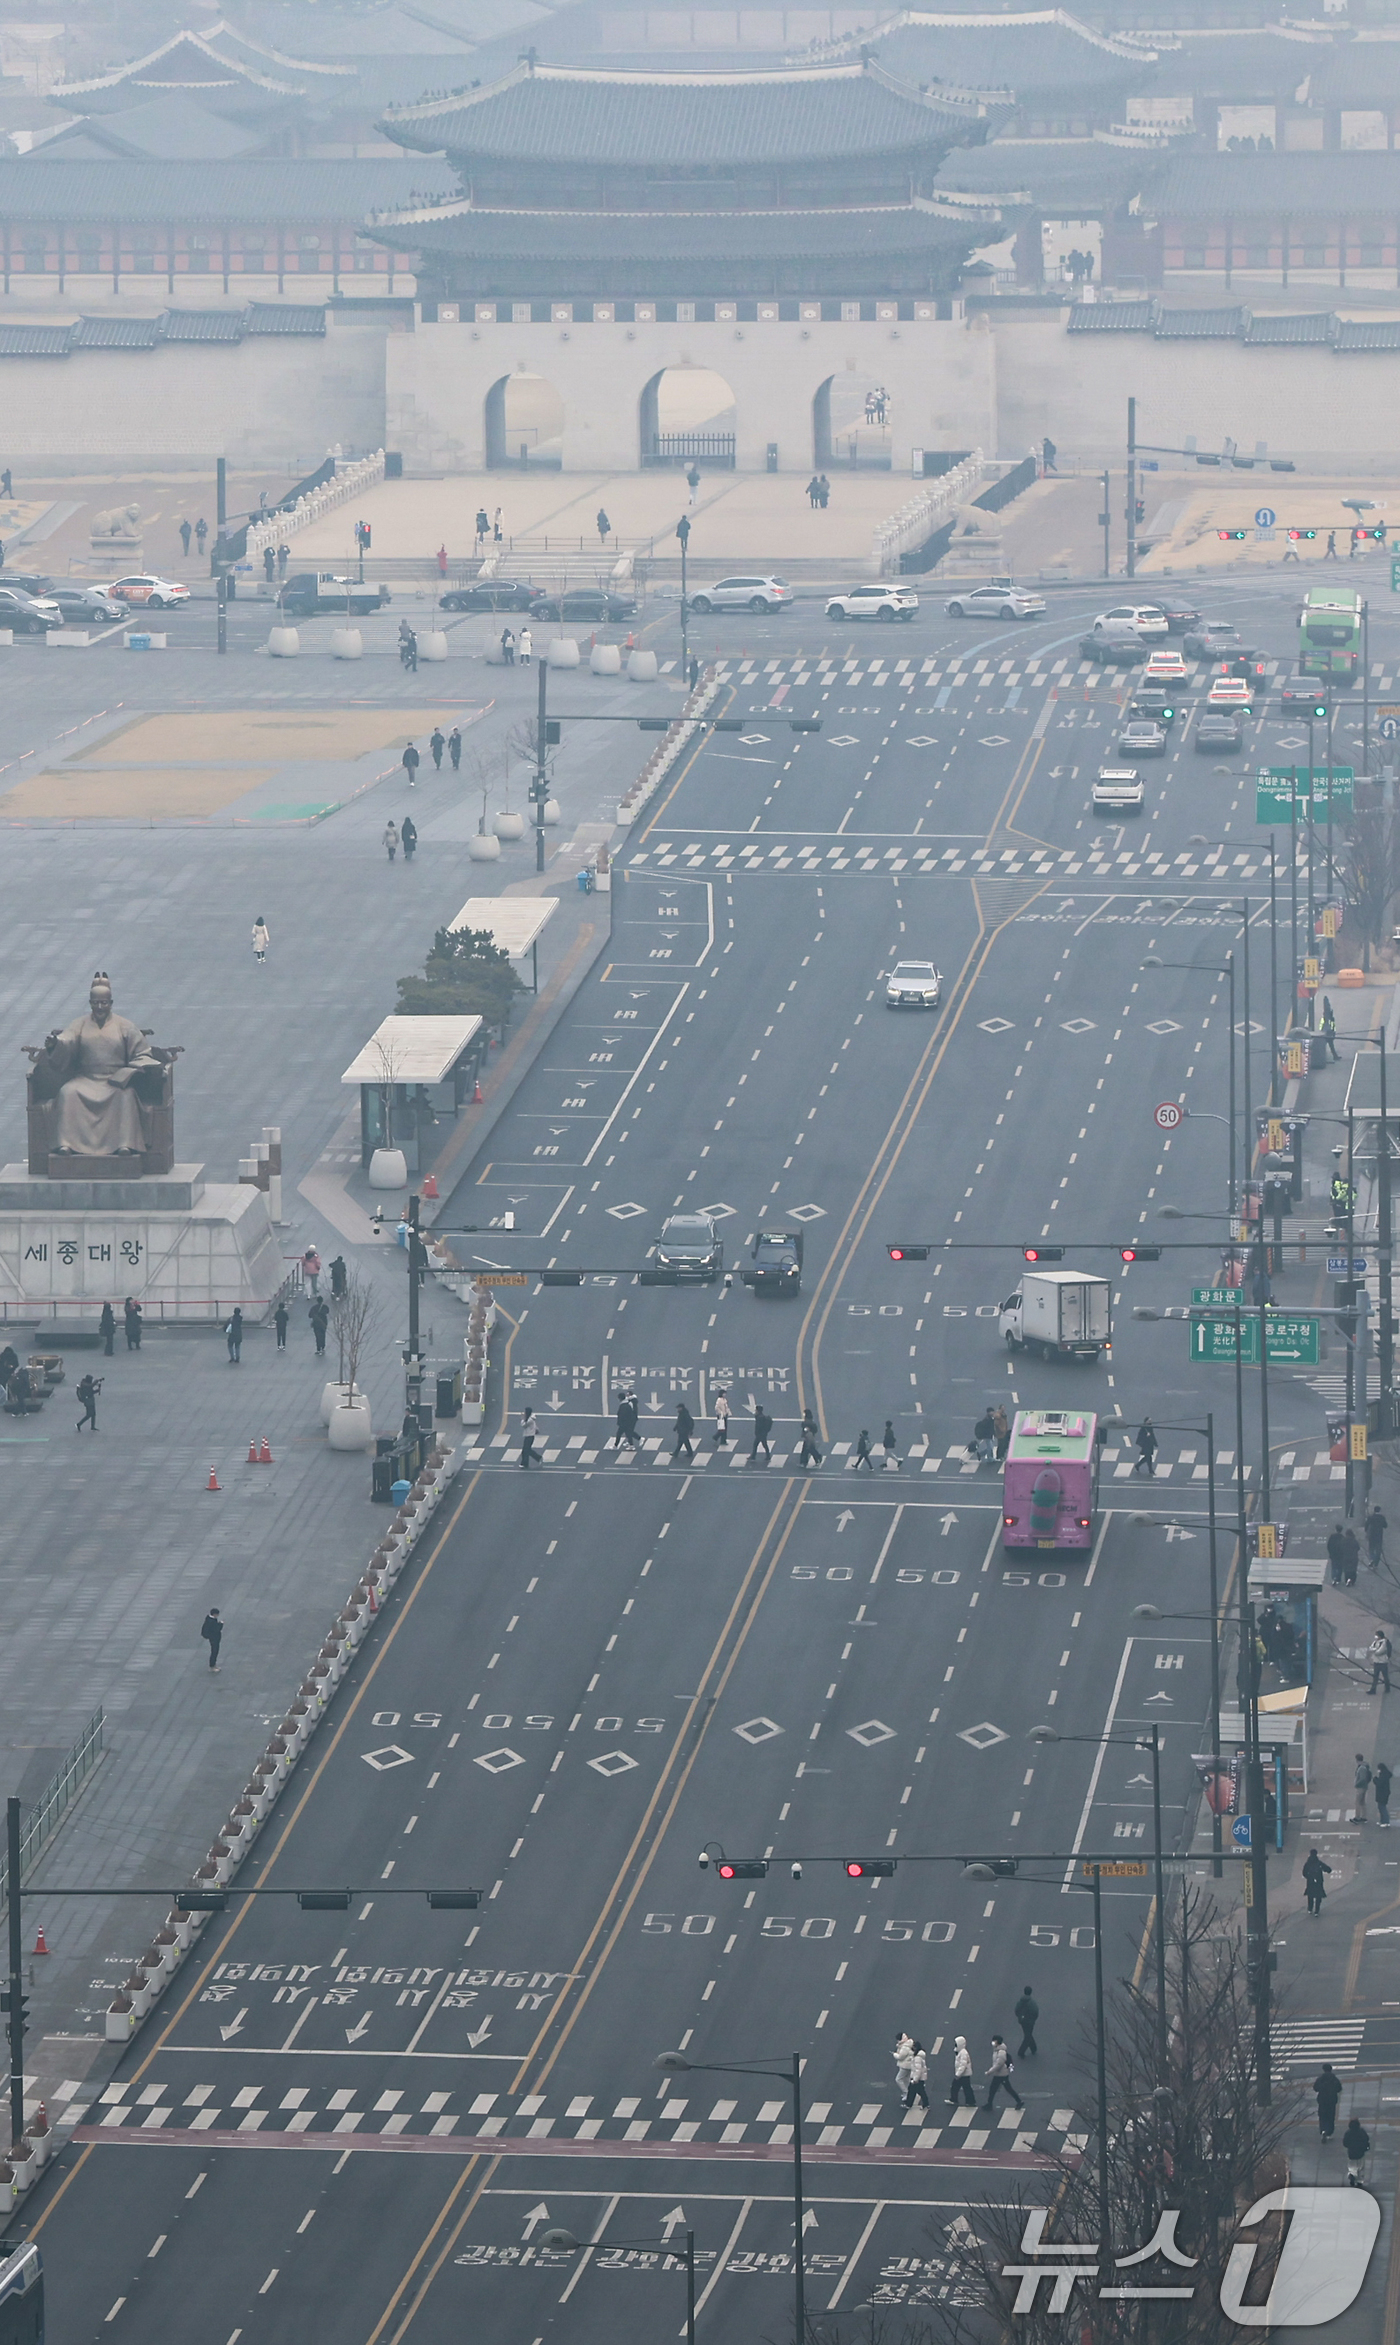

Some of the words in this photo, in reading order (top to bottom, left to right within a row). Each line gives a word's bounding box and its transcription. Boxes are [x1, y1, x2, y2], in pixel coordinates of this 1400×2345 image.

[1160, 1109, 1177, 1123] 50
[24, 1240, 144, 1265] 세종대왕
[1200, 1291, 1236, 1303] 광화문
[847, 1305, 903, 1317] 50
[943, 1305, 1000, 1318] 50
[1265, 1324, 1311, 1336] 종로구청
[790, 1566, 854, 1581] 50
[895, 1569, 961, 1585] 50
[1002, 1571, 1067, 1587] 50
[641, 1913, 717, 1935] 50
[760, 1916, 837, 1940] 50
[881, 1919, 957, 1943] 50
[1029, 1924, 1097, 1949] 50
[212, 1963, 322, 1982] 시의회
[335, 1966, 444, 1985] 시의회
[455, 1969, 562, 1988] 시의회
[454, 2245, 576, 2267] 광화문
[595, 2248, 718, 2272] 광화문
[725, 2252, 848, 2275] 광화문
